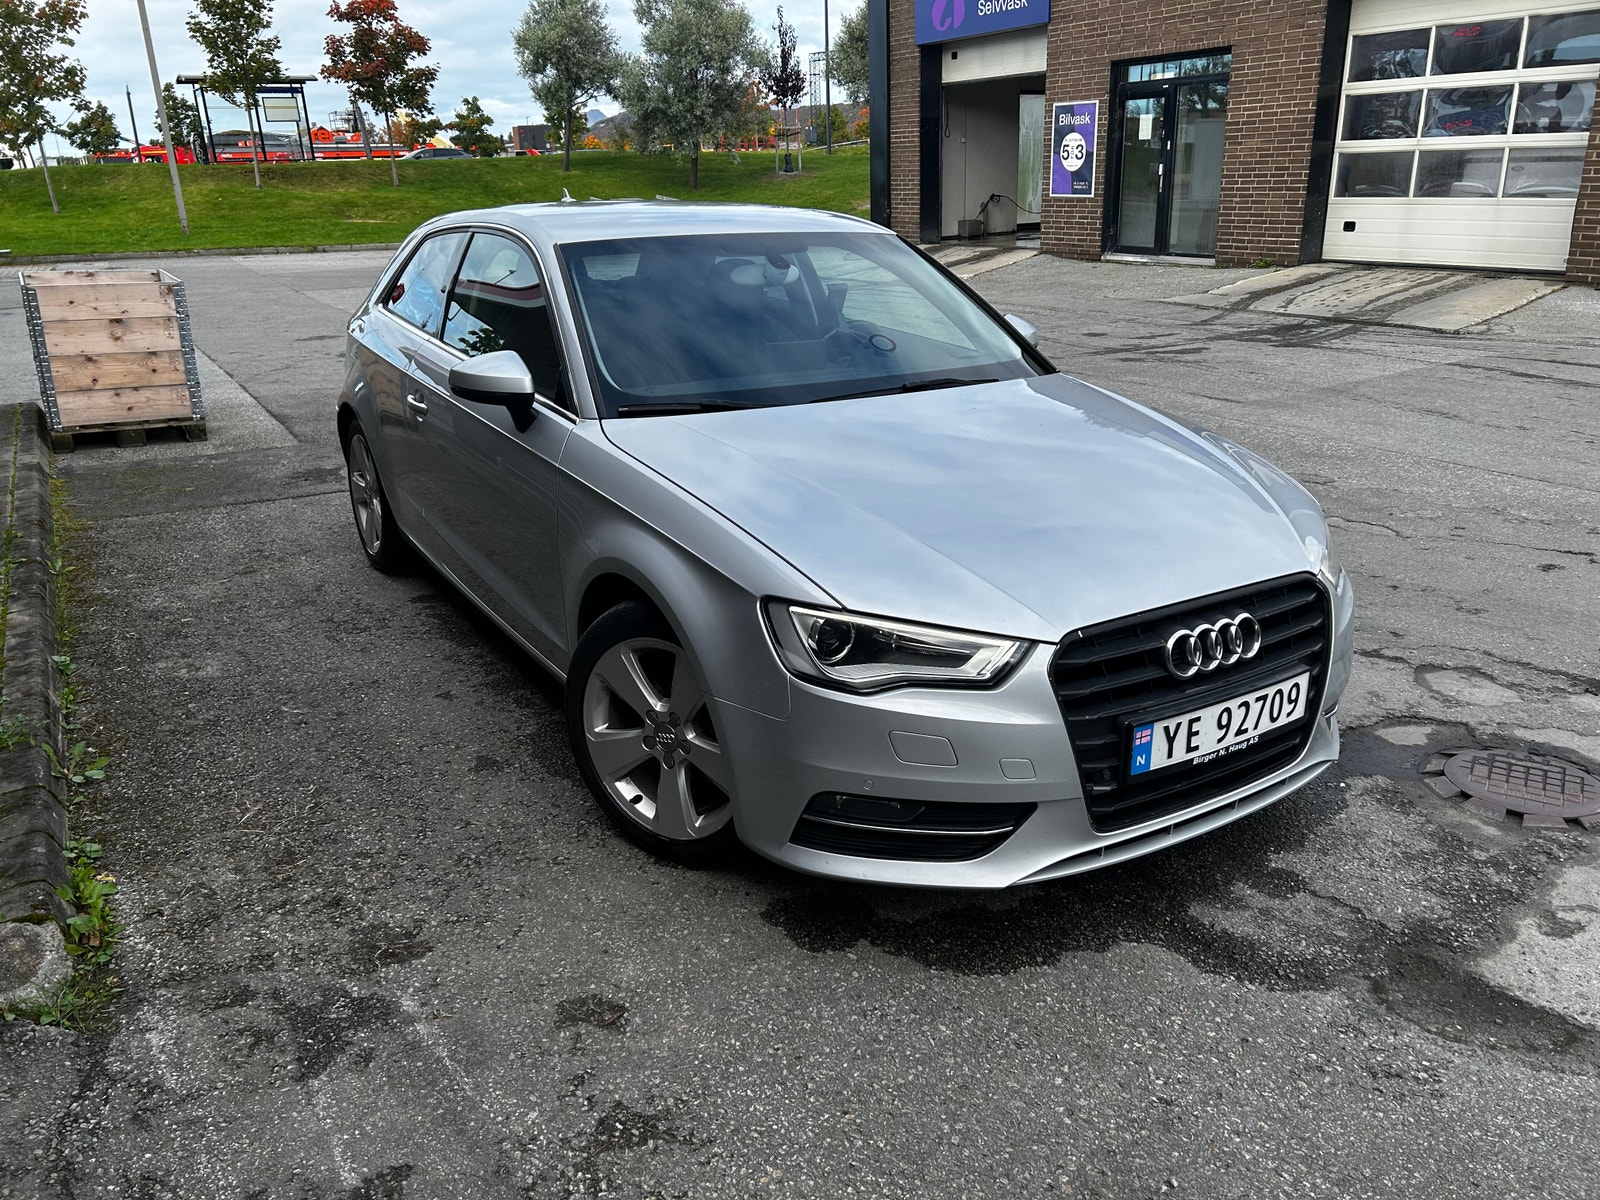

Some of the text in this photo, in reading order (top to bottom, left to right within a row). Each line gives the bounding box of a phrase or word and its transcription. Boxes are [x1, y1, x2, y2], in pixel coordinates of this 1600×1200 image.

[1059, 112, 1091, 126] Bilvask
[1061, 144, 1070, 160] 5
[1075, 144, 1084, 160] 3
[1163, 681, 1301, 760] YE 92709
[1193, 735, 1259, 765] Birger N. Haug AS
[1136, 754, 1146, 766] N
